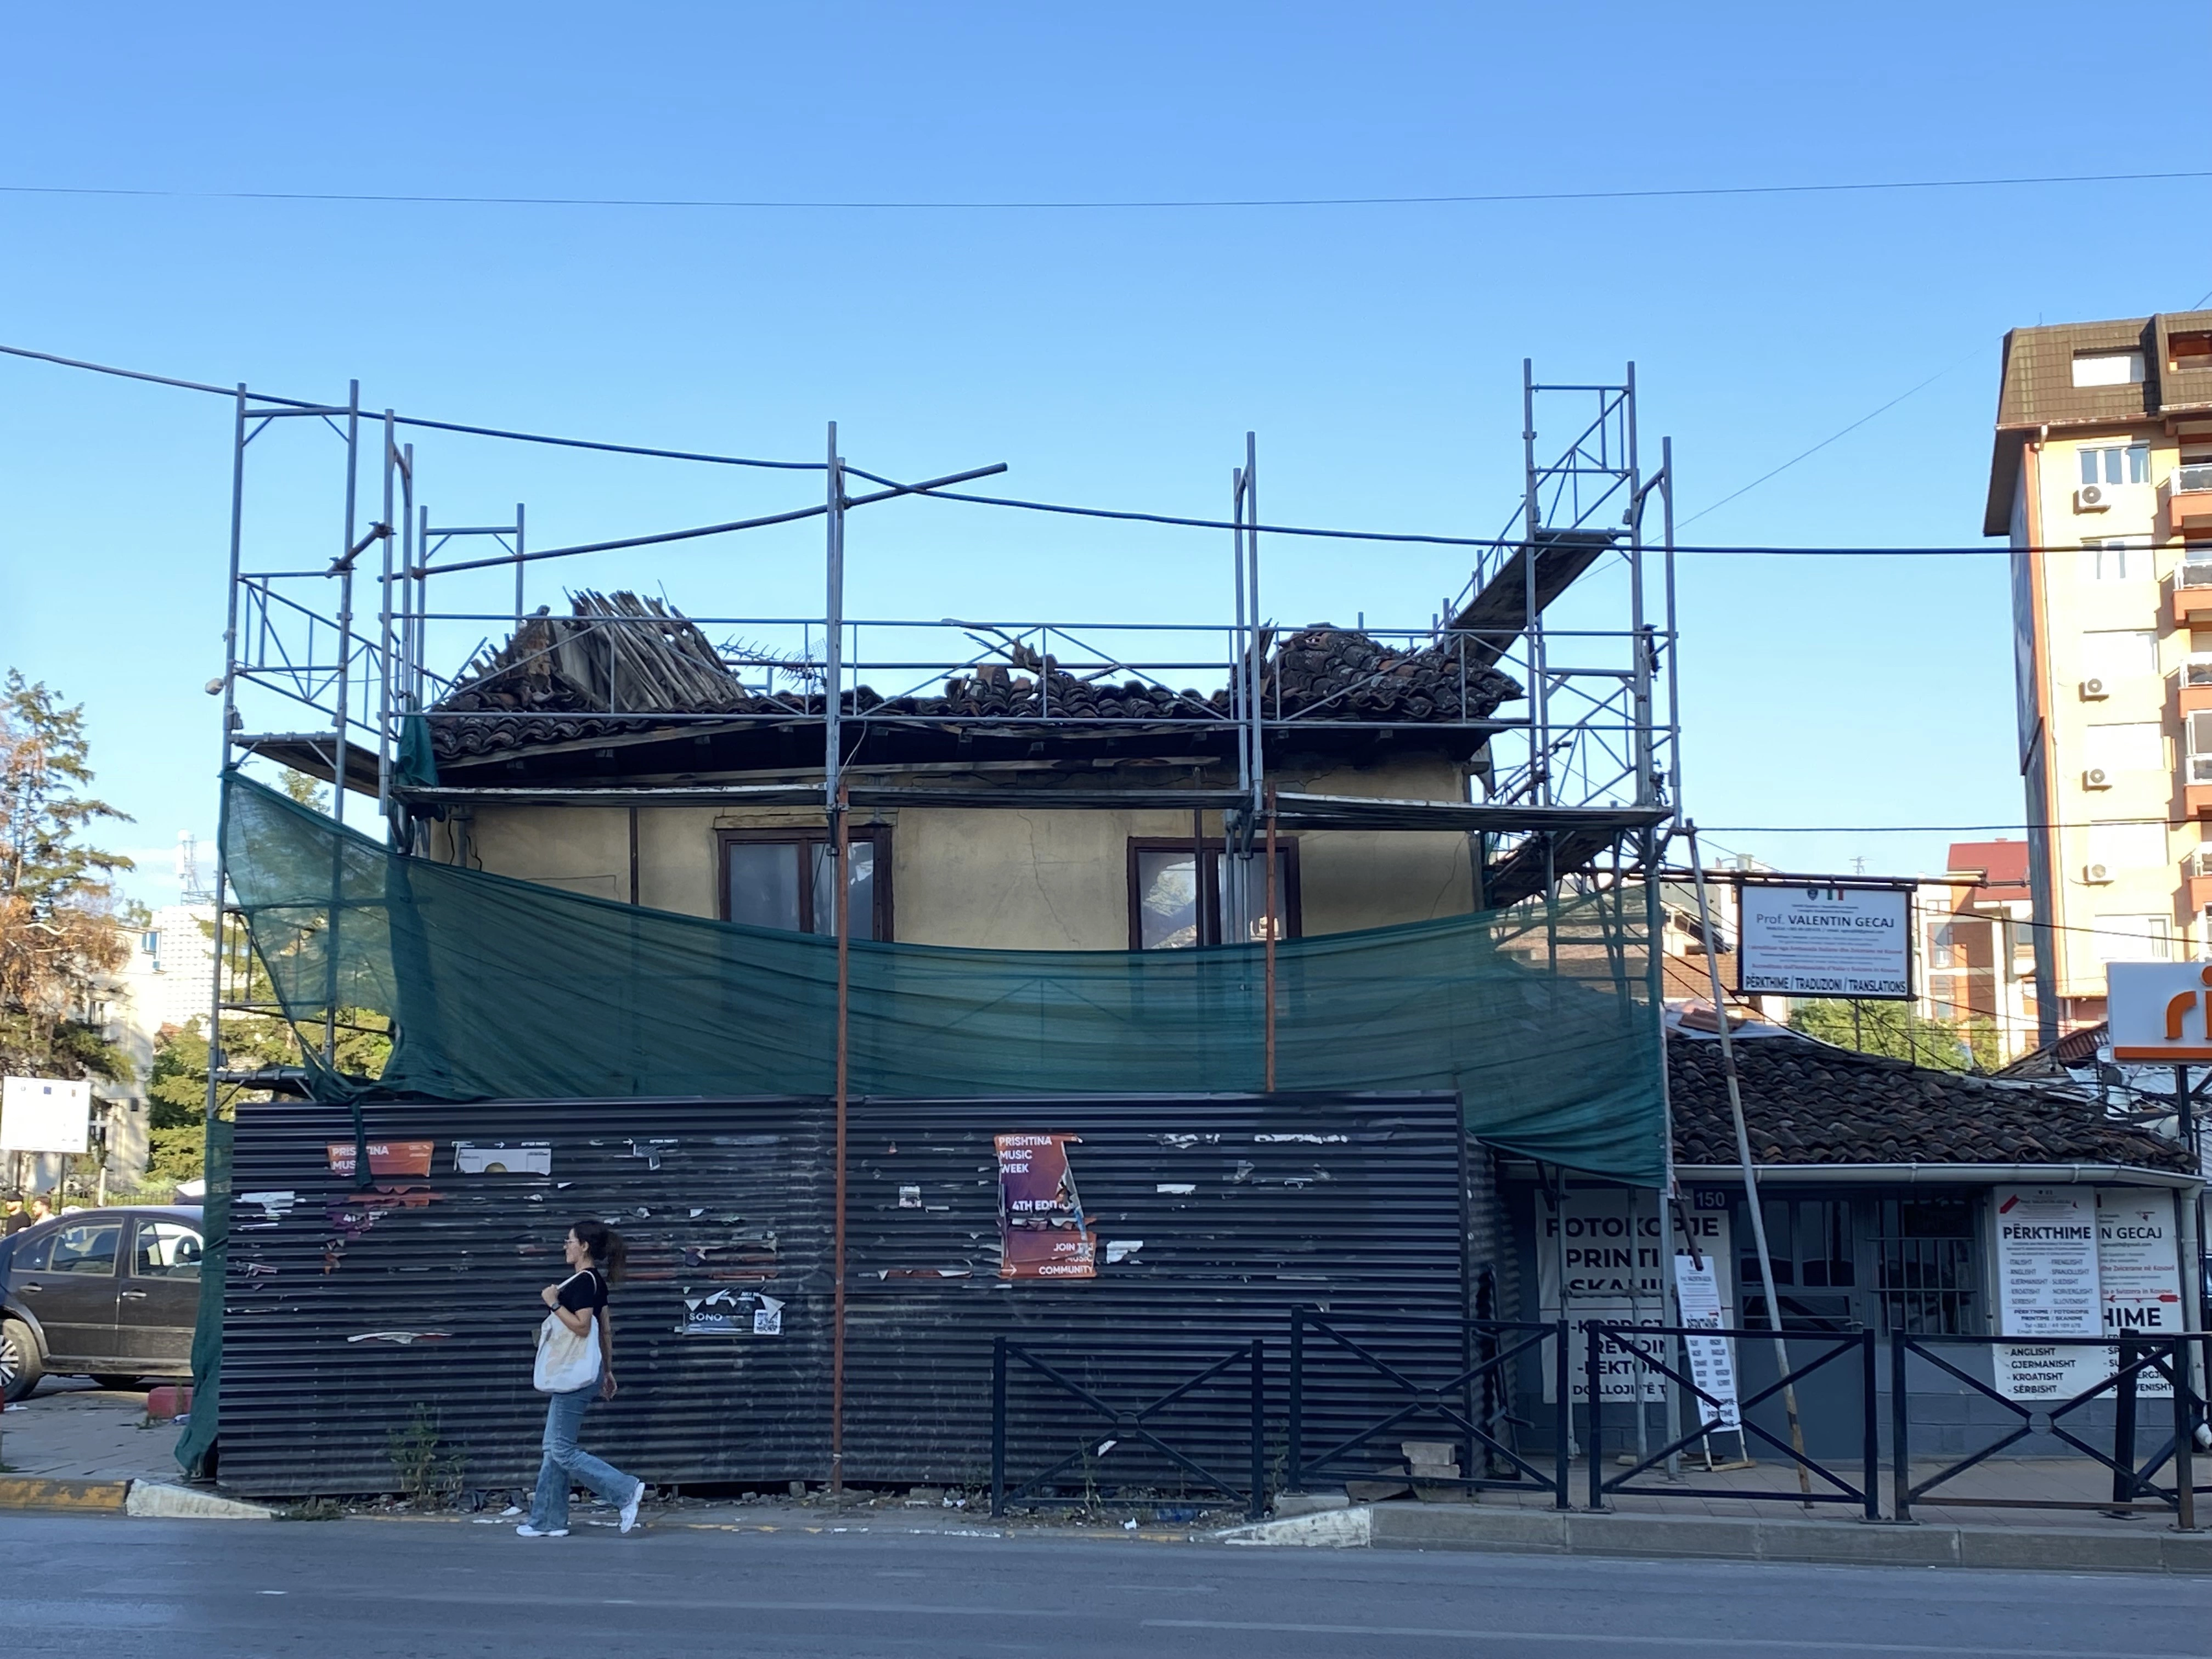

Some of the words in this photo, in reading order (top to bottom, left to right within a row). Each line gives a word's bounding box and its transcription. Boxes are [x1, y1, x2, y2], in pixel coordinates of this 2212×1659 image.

[1757, 914, 1785, 924] Prof.
[1788, 915, 1851, 926] VALENTIN
[1855, 917, 1894, 928] GECAJ
[1746, 973, 1789, 989] PËRKTHIME
[1795, 978, 1842, 990] TRADUZIONI
[1848, 979, 1906, 992] TRANSLATIONS
[998, 1136, 1052, 1146] PRISHTINA
[1000, 1150, 1032, 1160] MUSIC
[332, 1160, 356, 1170] MUS
[1000, 1163, 1029, 1173] WEEK
[1696, 1192, 1725, 1207] 150
[2003, 1223, 2091, 1239] PËRKTHIME
[2117, 1227, 2162, 1239] GECAJ
[1053, 1243, 1075, 1251] JOIN
[1039, 1265, 1093, 1275] COMMUNITY
[689, 1312, 723, 1321] SONO
[2011, 1347, 2056, 1356] ANGLISHT
[2011, 1359, 2076, 1368] GJERMANISHT
[2013, 1373, 2063, 1381] KROATISHT
